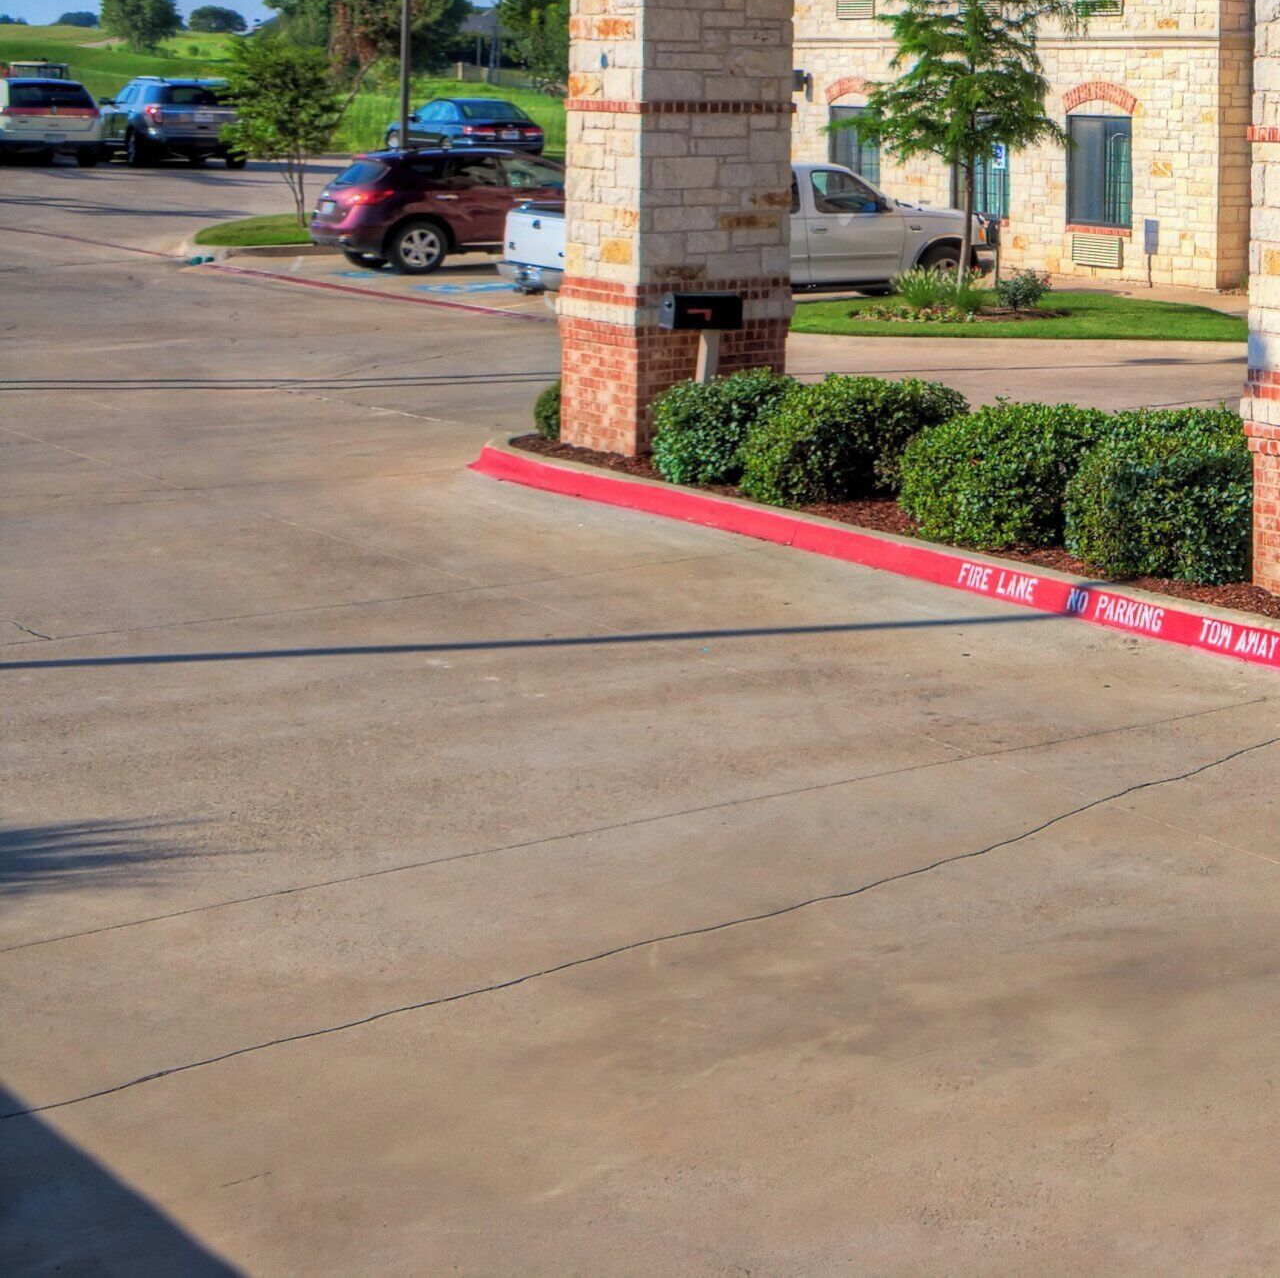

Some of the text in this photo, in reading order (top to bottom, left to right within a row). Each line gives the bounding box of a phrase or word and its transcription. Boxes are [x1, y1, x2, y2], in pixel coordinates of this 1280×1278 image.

[957, 562, 993, 590] FIRE
[996, 572, 1039, 602] LANE
[1065, 588, 1090, 614] NO
[1094, 595, 1166, 633] PARKING
[1199, 619, 1233, 650] TOW
[1234, 630, 1280, 660] AWAY
